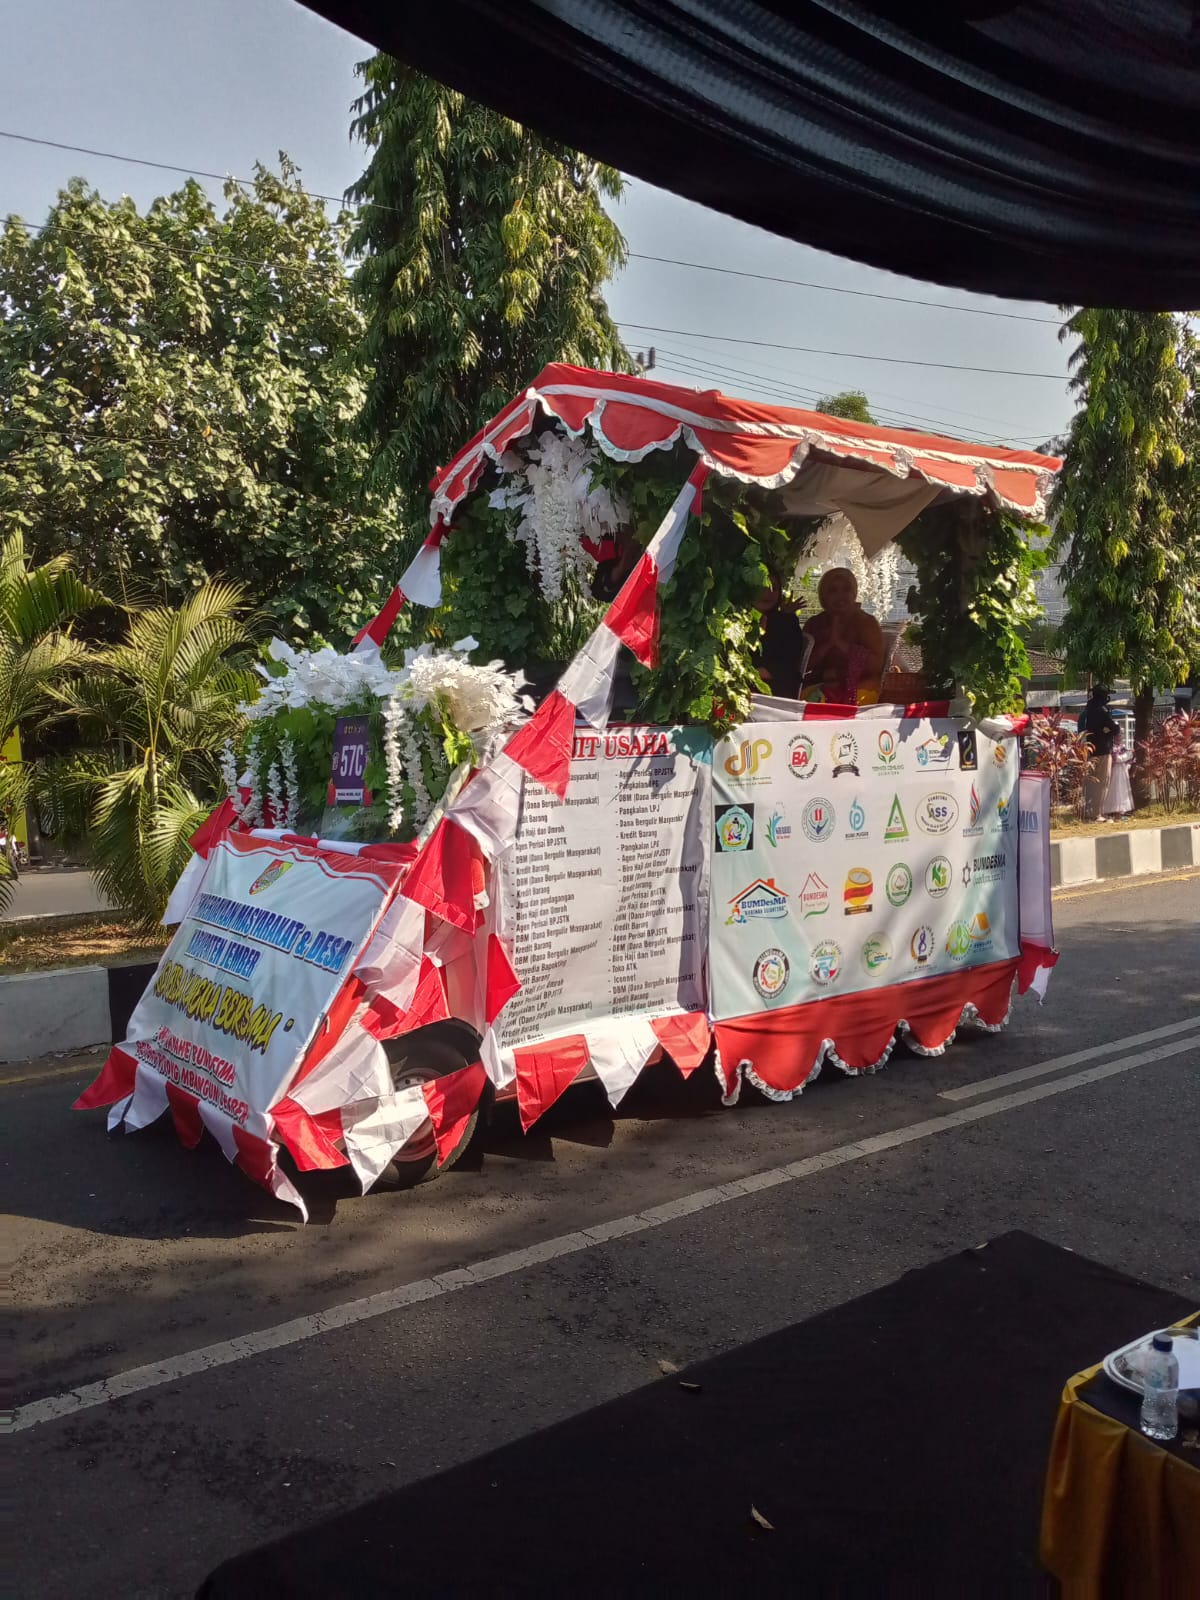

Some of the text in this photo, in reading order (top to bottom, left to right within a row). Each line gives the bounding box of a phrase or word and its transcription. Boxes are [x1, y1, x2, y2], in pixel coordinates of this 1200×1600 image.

[603, 734, 670, 758] USAHA
[340, 744, 364, 776] 57C
[570, 772, 600, 782] asyarakat)
[547, 837, 567, 847] BPJSTK
[974, 853, 1006, 872] BUMDESMA
[741, 897, 786, 909] BUMDesMA
[549, 915, 570, 925] BPJSTK
[233, 903, 305, 950] MASYARAKAT
[294, 931, 311, 955] &
[306, 931, 354, 971] DESA
